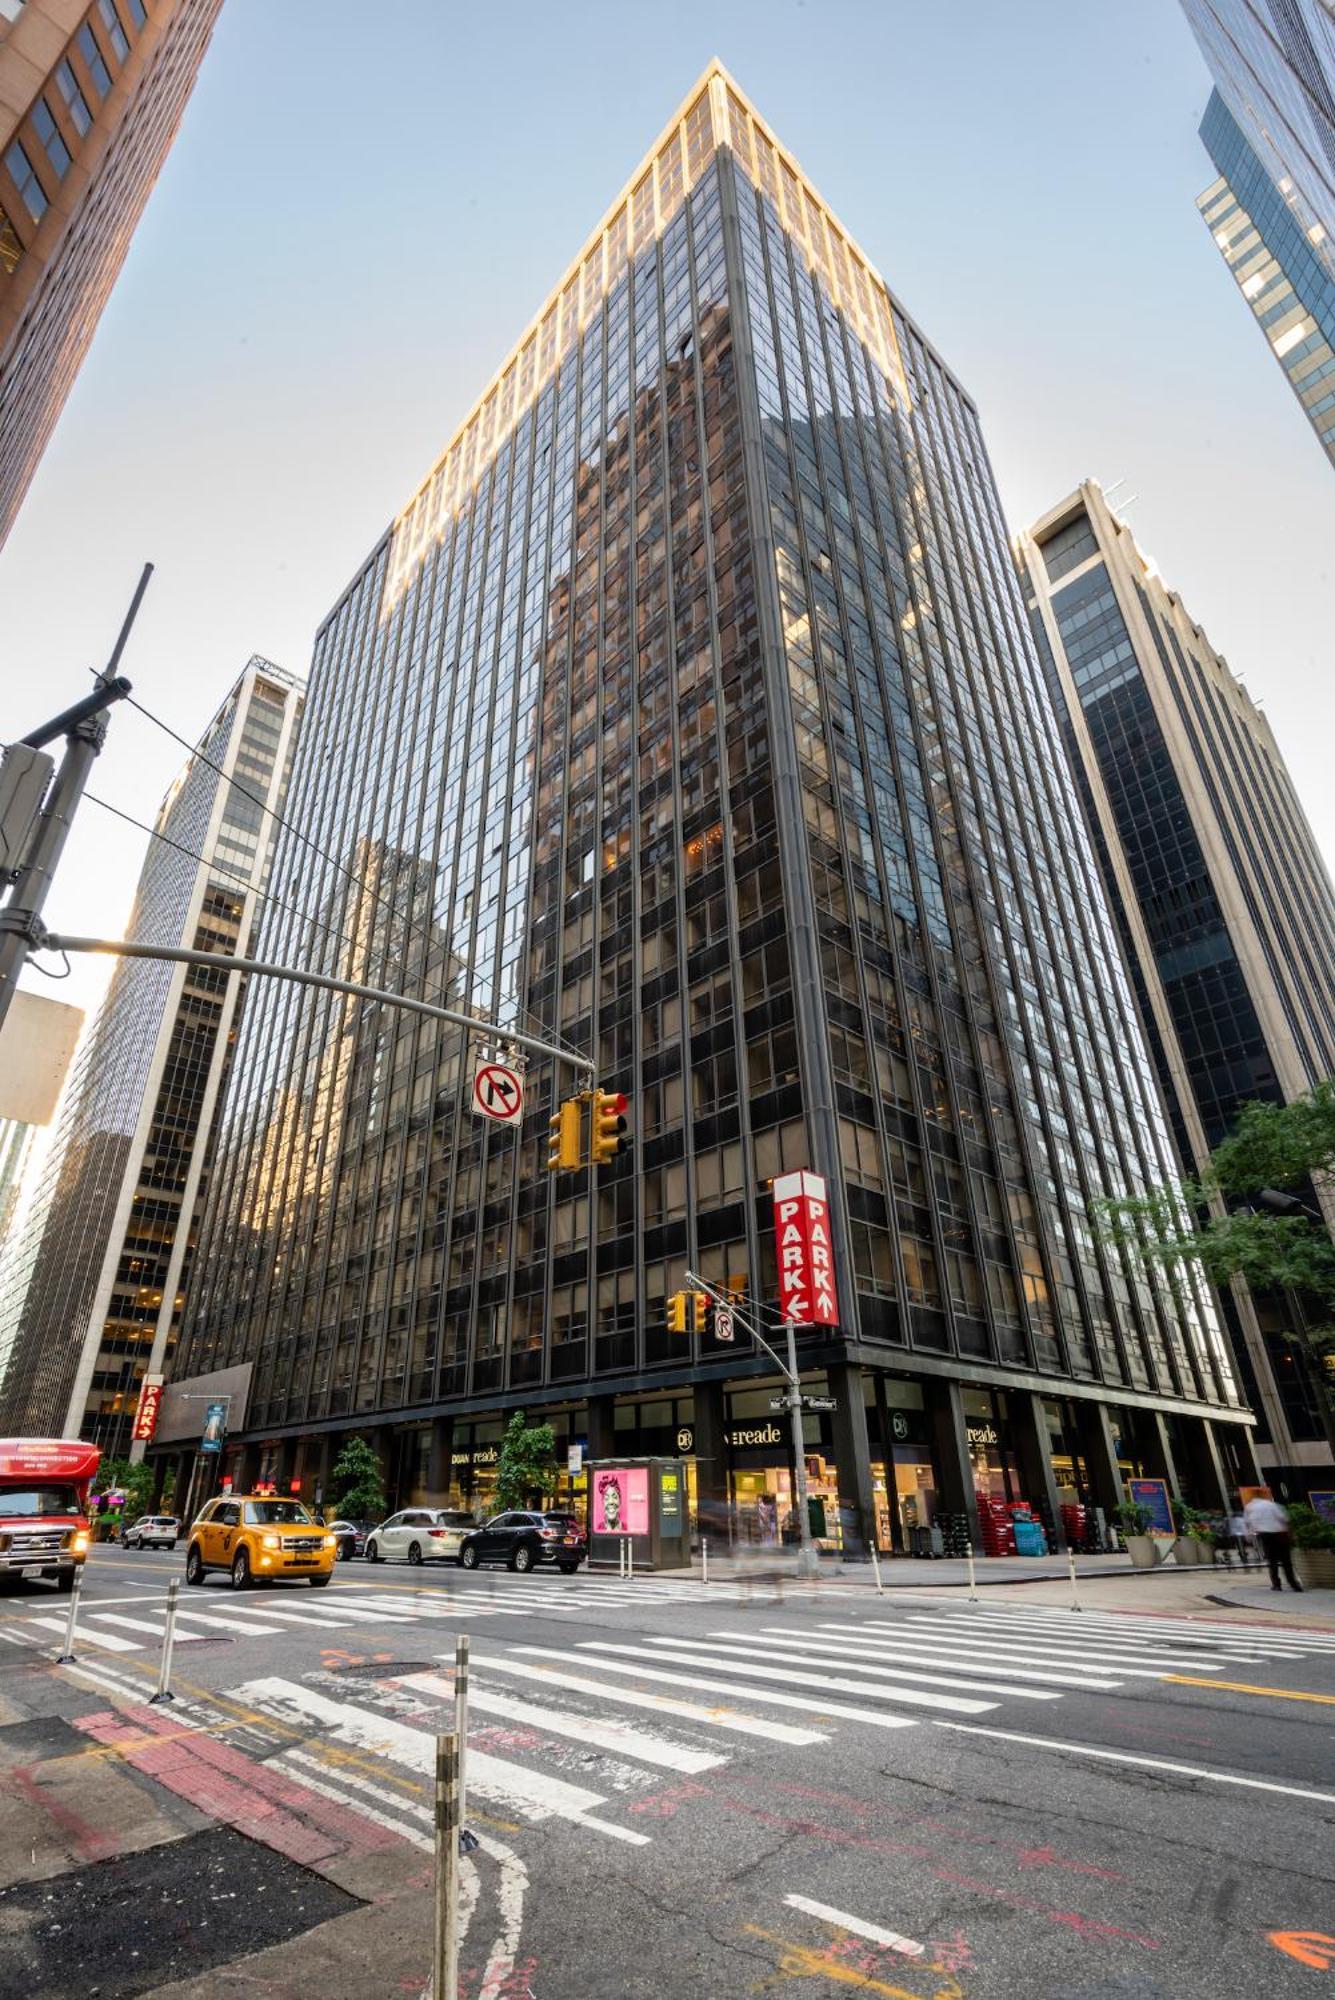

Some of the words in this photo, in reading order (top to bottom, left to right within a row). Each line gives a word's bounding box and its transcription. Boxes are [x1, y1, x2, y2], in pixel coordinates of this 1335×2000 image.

[780, 1202, 806, 1292] PARK
[809, 1200, 832, 1291] PARK
[140, 1386, 159, 1425] PARK
